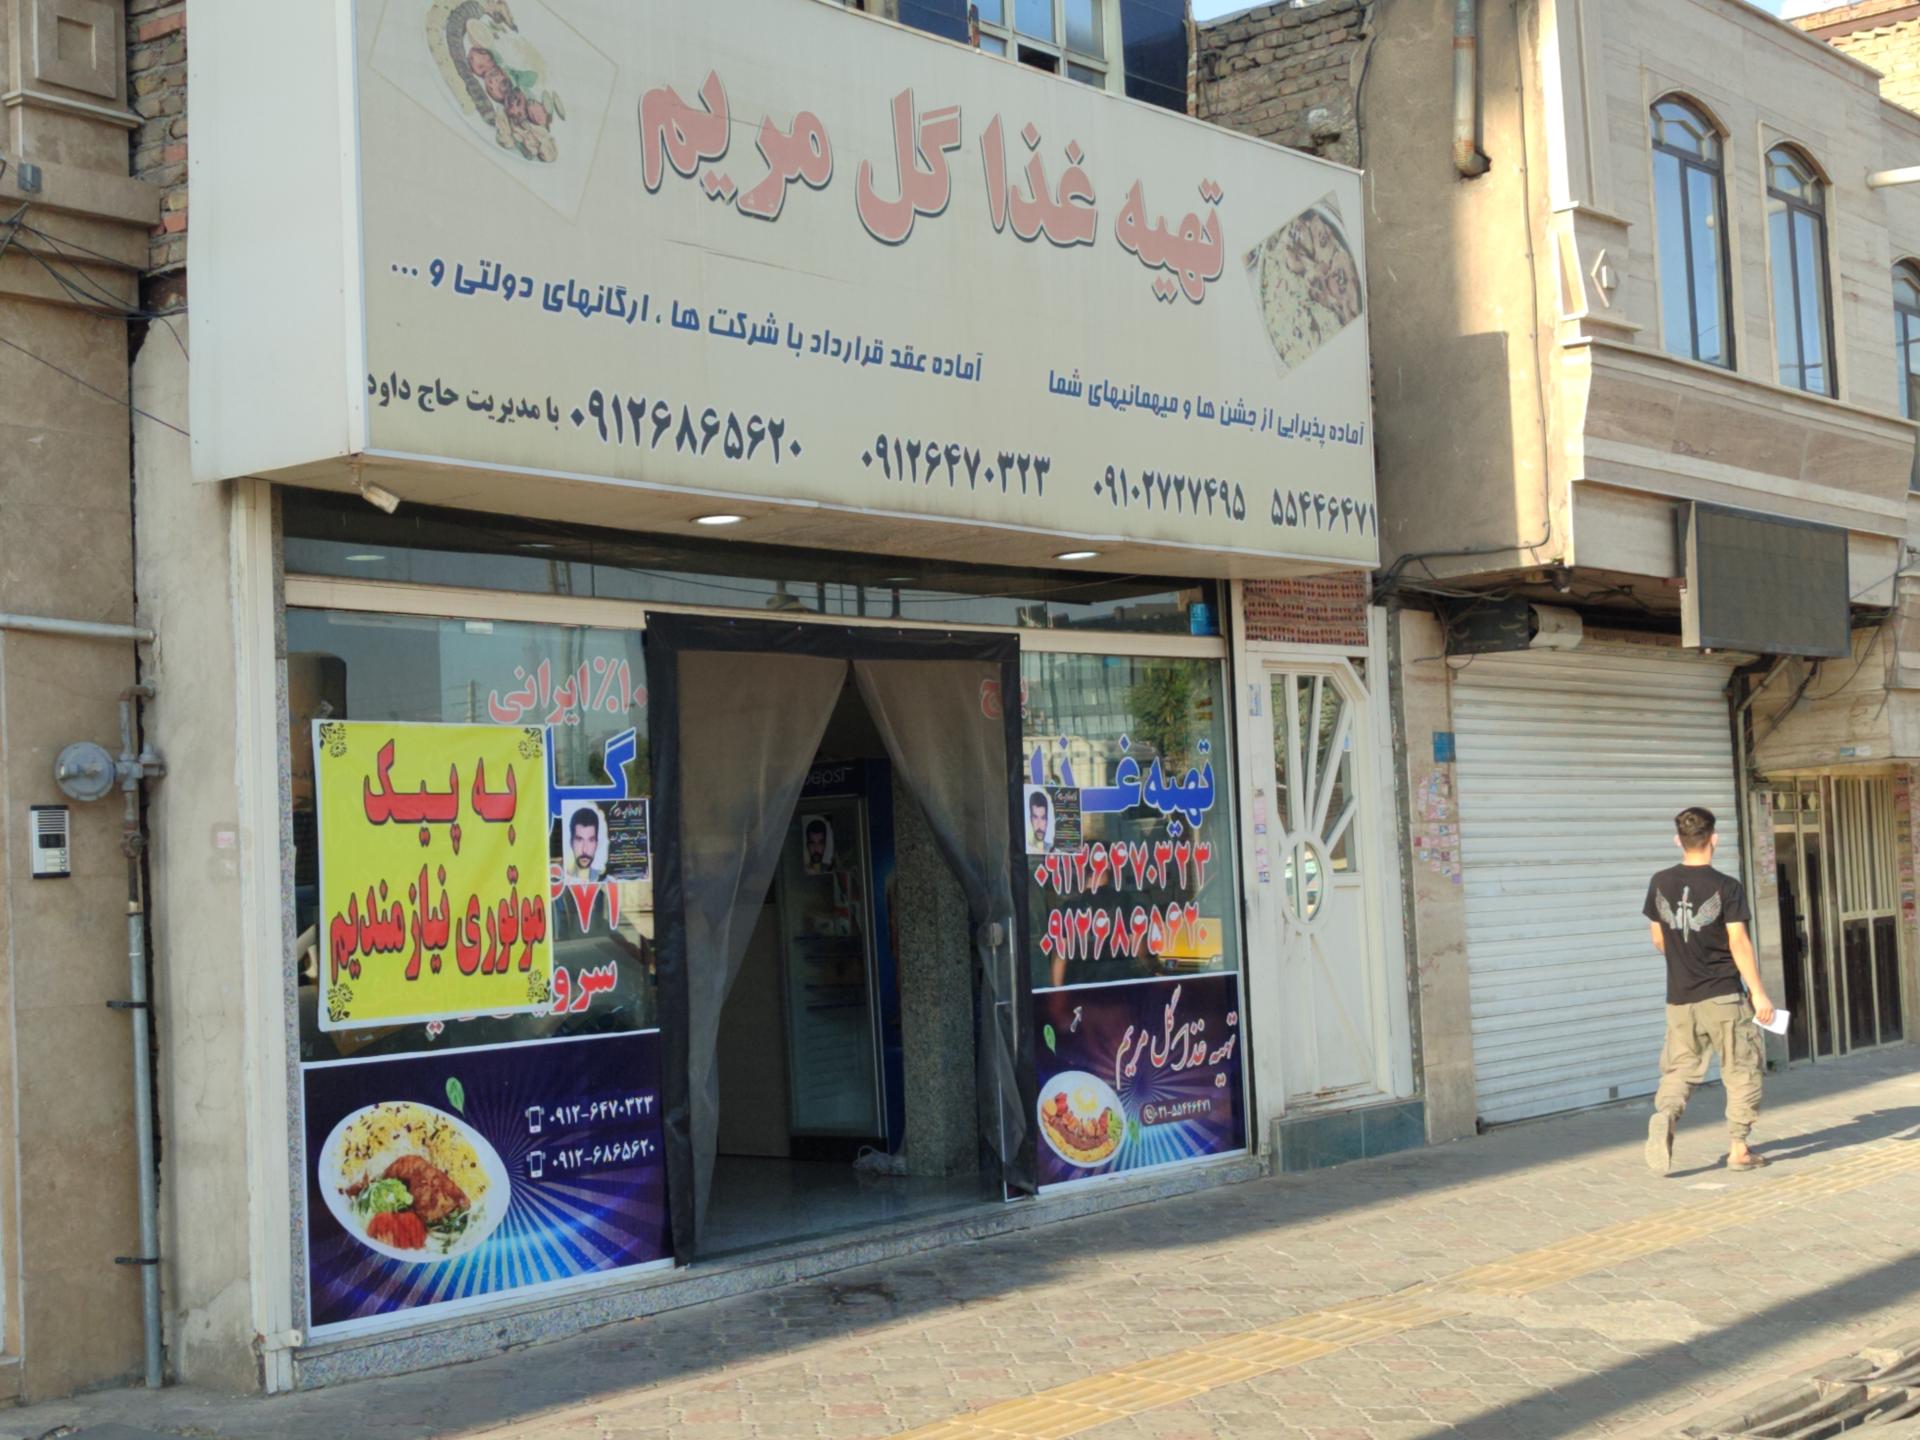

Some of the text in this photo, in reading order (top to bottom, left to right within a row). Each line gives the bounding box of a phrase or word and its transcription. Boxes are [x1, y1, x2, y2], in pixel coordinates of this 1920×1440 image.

[638, 67, 1225, 304] تهیه غذا گل مریم
[428, 257, 446, 288] و
[453, 259, 534, 302] دولتی
[541, 278, 650, 325] ارگانهای
[671, 299, 701, 331] ها
[707, 308, 780, 346] شرکت
[786, 322, 804, 358] با
[809, 329, 885, 367] قرارداد
[889, 344, 927, 373] عقد
[931, 351, 984, 382] آماده
[366, 370, 560, 431] با مدیریت حاج داود
[569, 387, 803, 465] ۰۹۱۲۶۸۶۵۶۲۰
[1048, 367, 1365, 449] آماده پذیرایی از جشن ها و میهمانیهای شما
[860, 433, 1052, 497] ۰۹۱۲۶۴۷۰۳۲۳
[1093, 464, 1247, 522] ۰۹۱۰۲۷۲۷۴۹۵
[1271, 487, 1377, 538] ۵۵۴۴۶۴۷۱
[487, 657, 591, 726] ایرانی
[363, 737, 462, 856] پیک
[471, 756, 518, 847] به
[1143, 736, 1216, 838] تهیه
[1033, 840, 1212, 895] ۰۹۱۲۶۴۷۰۳۲۳
[329, 862, 547, 986] موتوری نیازمندیم
[1039, 901, 1209, 961] ۰۹۱۲۶۸۶۵۶۲۰
